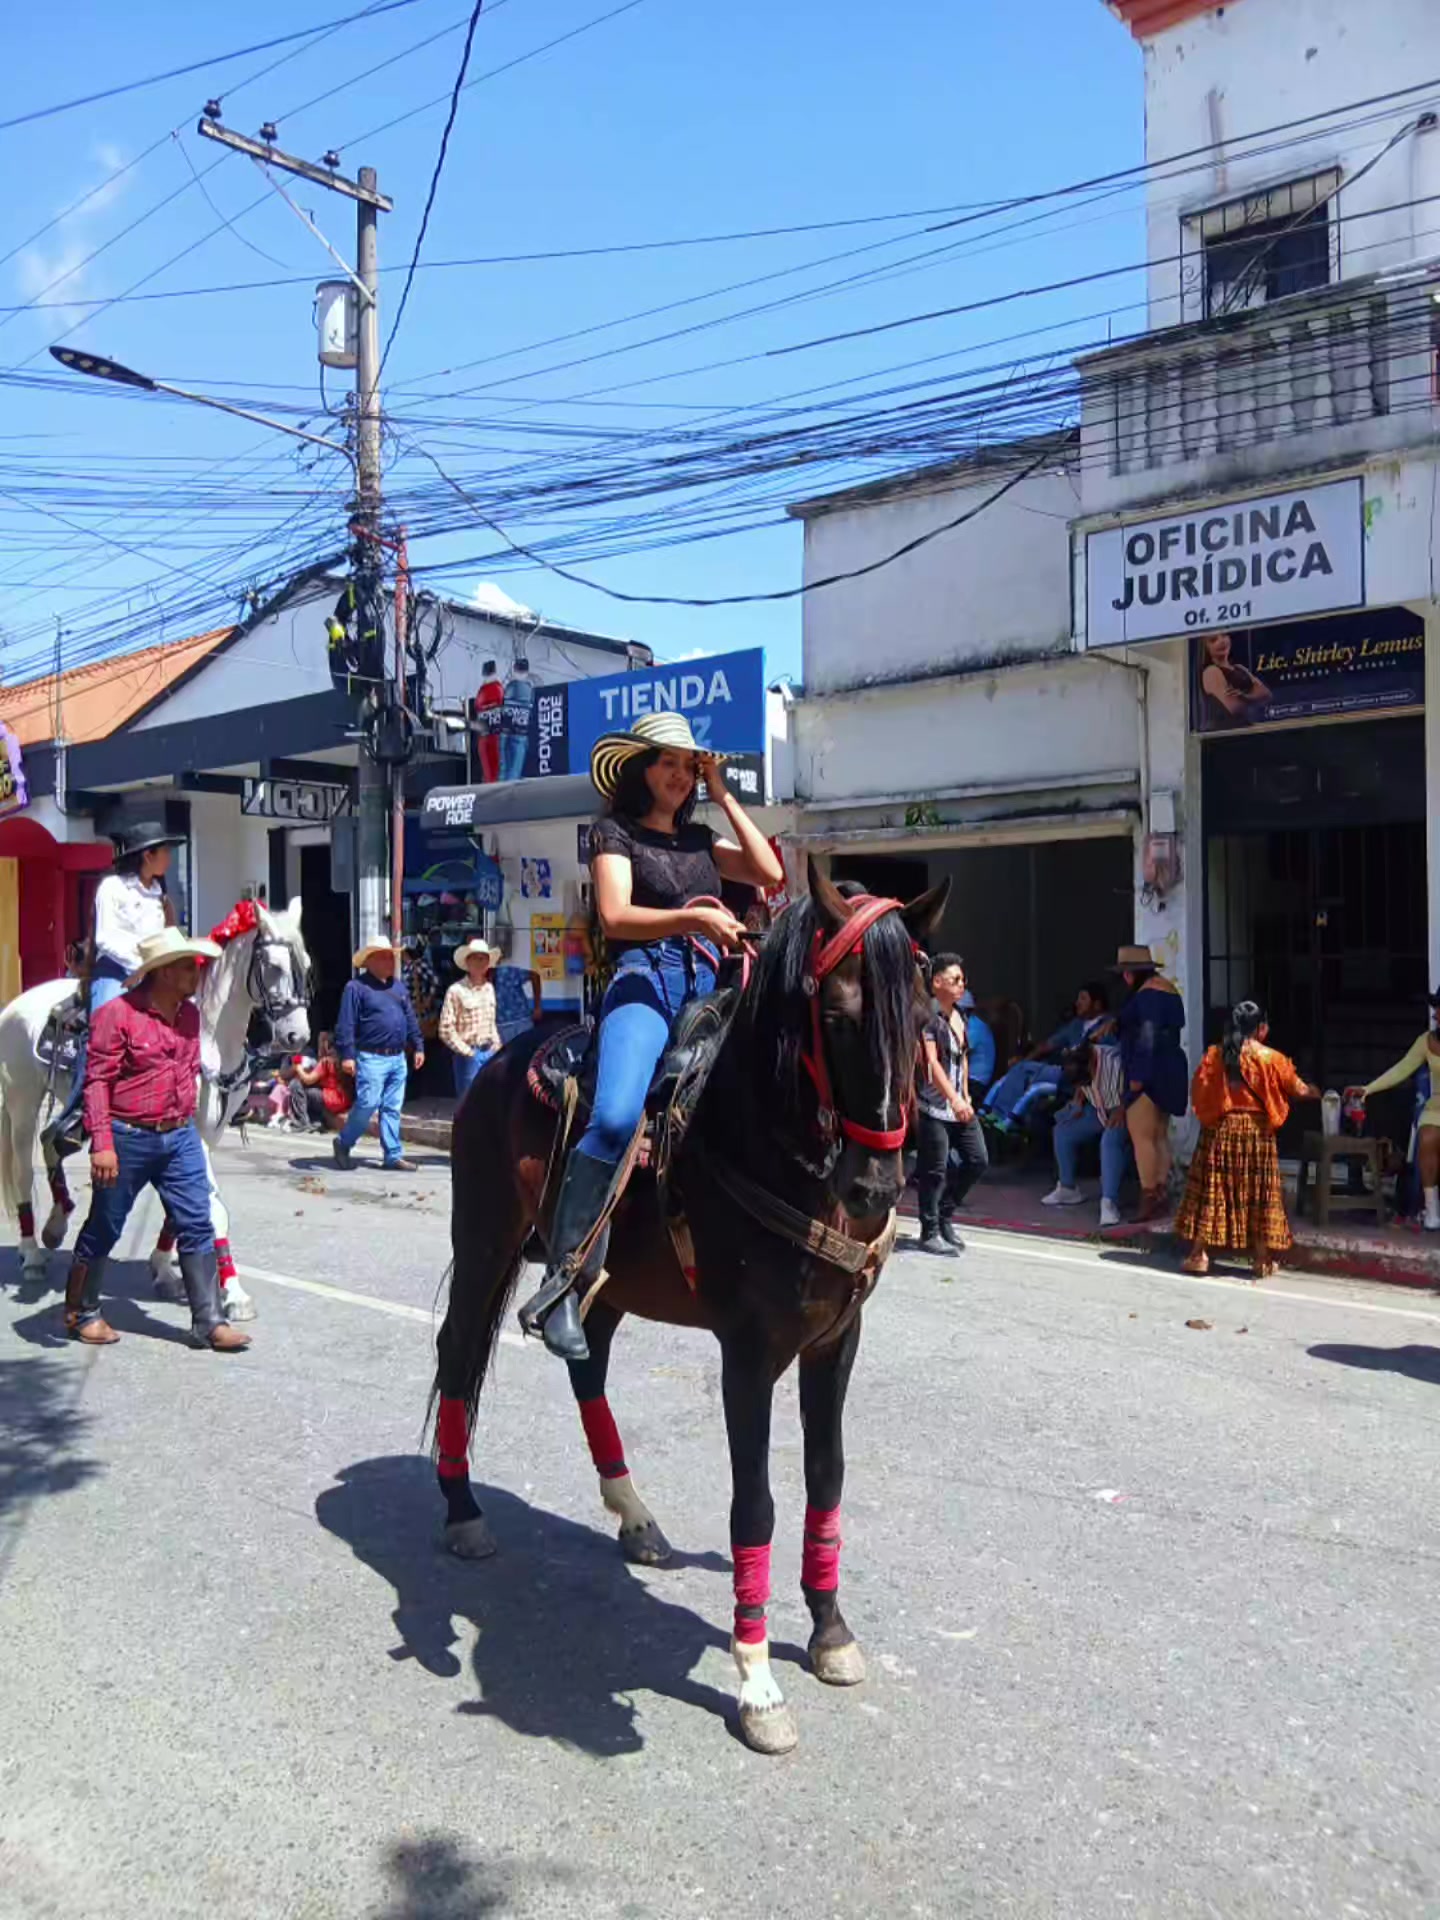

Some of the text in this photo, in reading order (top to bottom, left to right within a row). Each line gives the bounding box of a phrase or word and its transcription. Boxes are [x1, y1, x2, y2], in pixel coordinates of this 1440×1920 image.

[1125, 500, 1316, 566] OFICINA
[1112, 542, 1333, 611] JURÍDICA
[1184, 600, 1252, 626] Of. 201
[1256, 635, 1423, 672] Lic. Shirley Lemus
[600, 669, 732, 720] TIENDA
[538, 695, 552, 774] POWER
[426, 793, 477, 812] POWER
